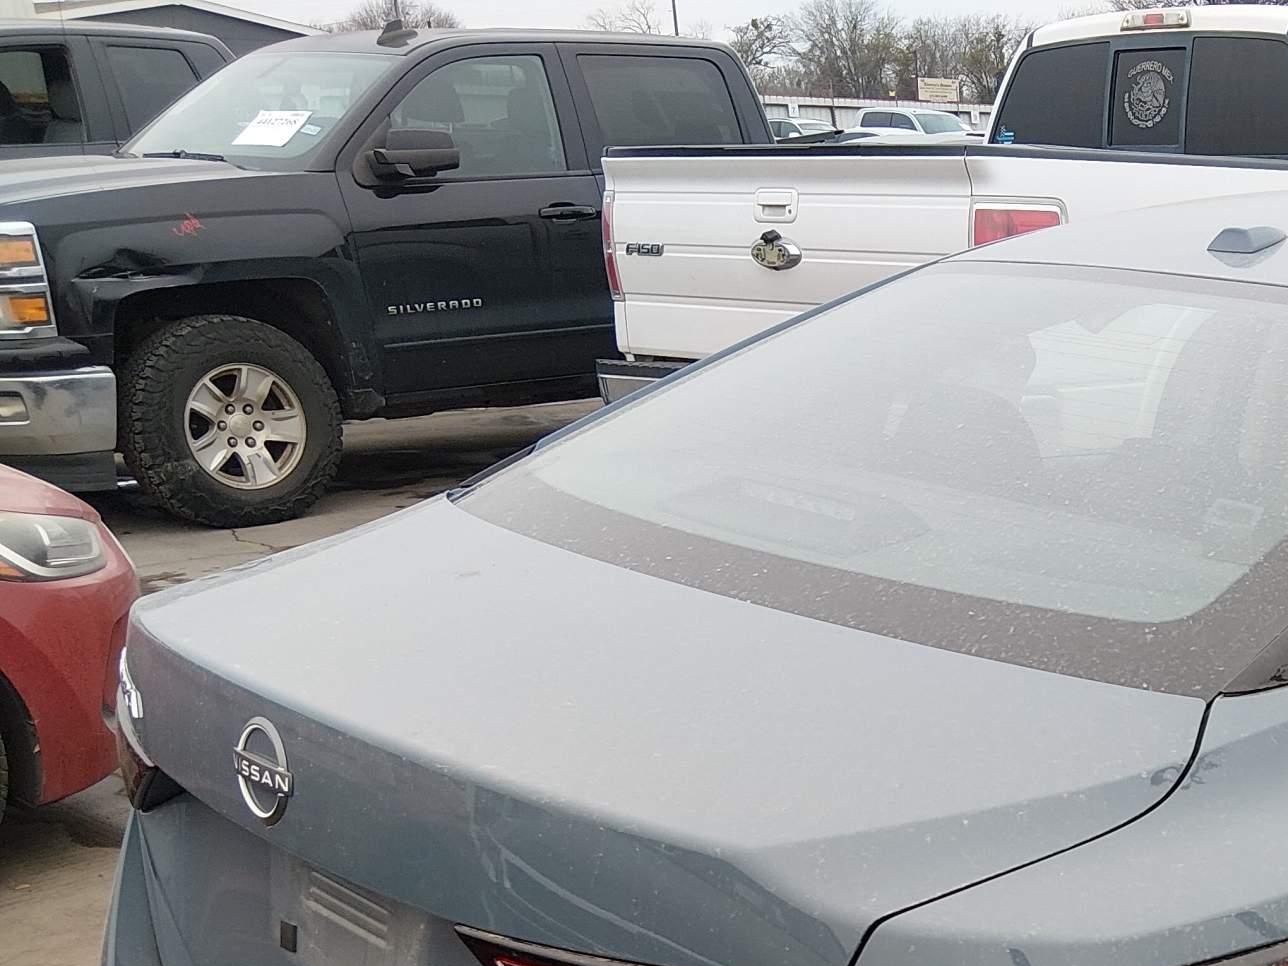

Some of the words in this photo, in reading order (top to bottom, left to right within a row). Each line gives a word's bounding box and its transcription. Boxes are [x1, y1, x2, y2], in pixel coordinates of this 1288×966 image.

[1127, 60, 1162, 78] GUERRERO
[387, 298, 482, 315] SILVERADO
[233, 750, 289, 793] NISSAN
